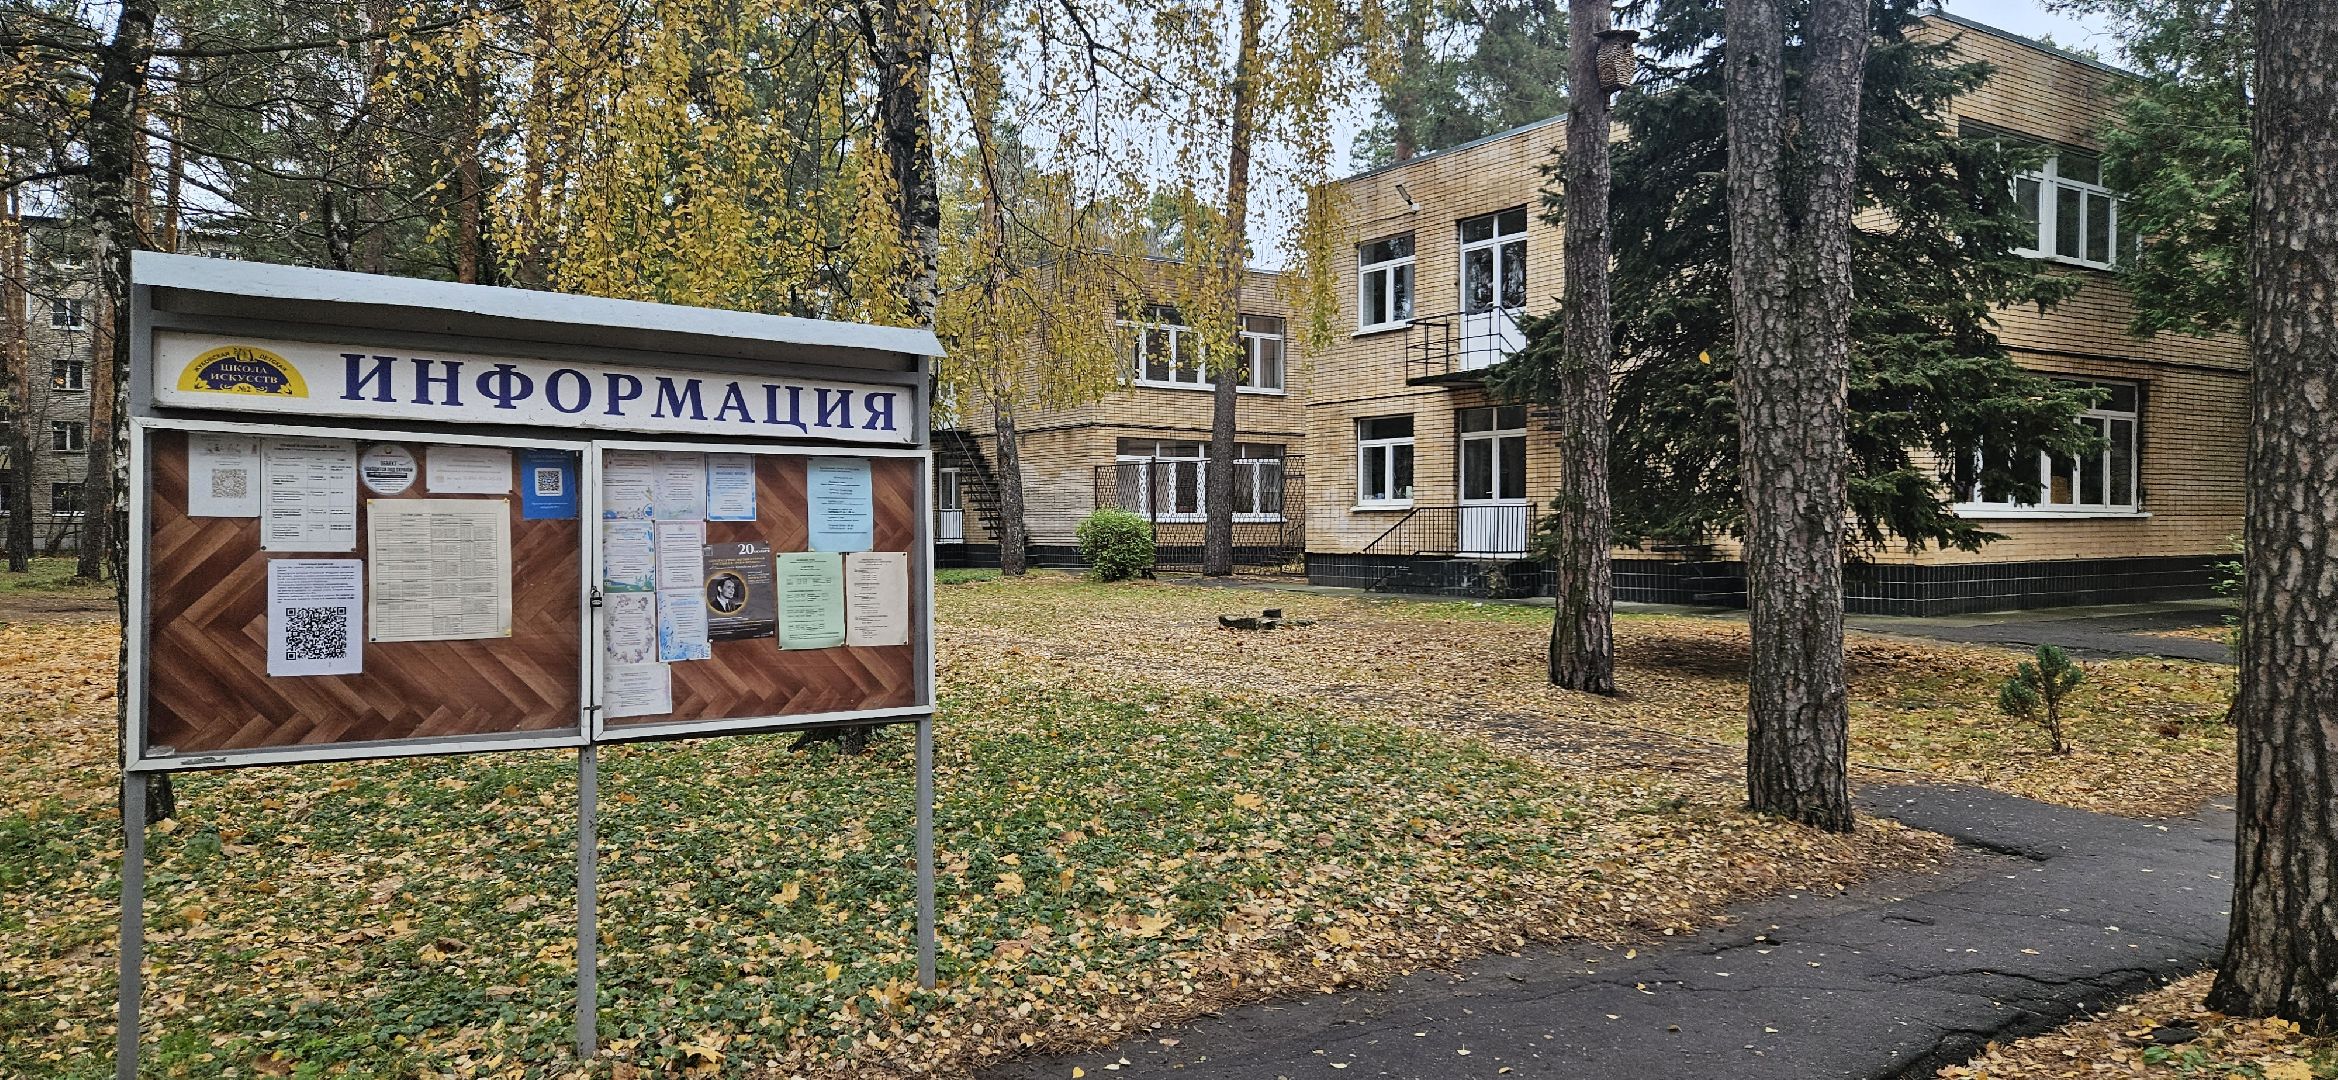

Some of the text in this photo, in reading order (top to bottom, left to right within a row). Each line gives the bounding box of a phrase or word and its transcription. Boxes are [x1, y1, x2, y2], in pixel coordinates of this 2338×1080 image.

[220, 363, 268, 375] ШКОЛА
[210, 373, 279, 384] ИСКУССТВ
[340, 353, 898, 435] ИНФОРМАЦИЯ
[737, 543, 755, 555] 20
